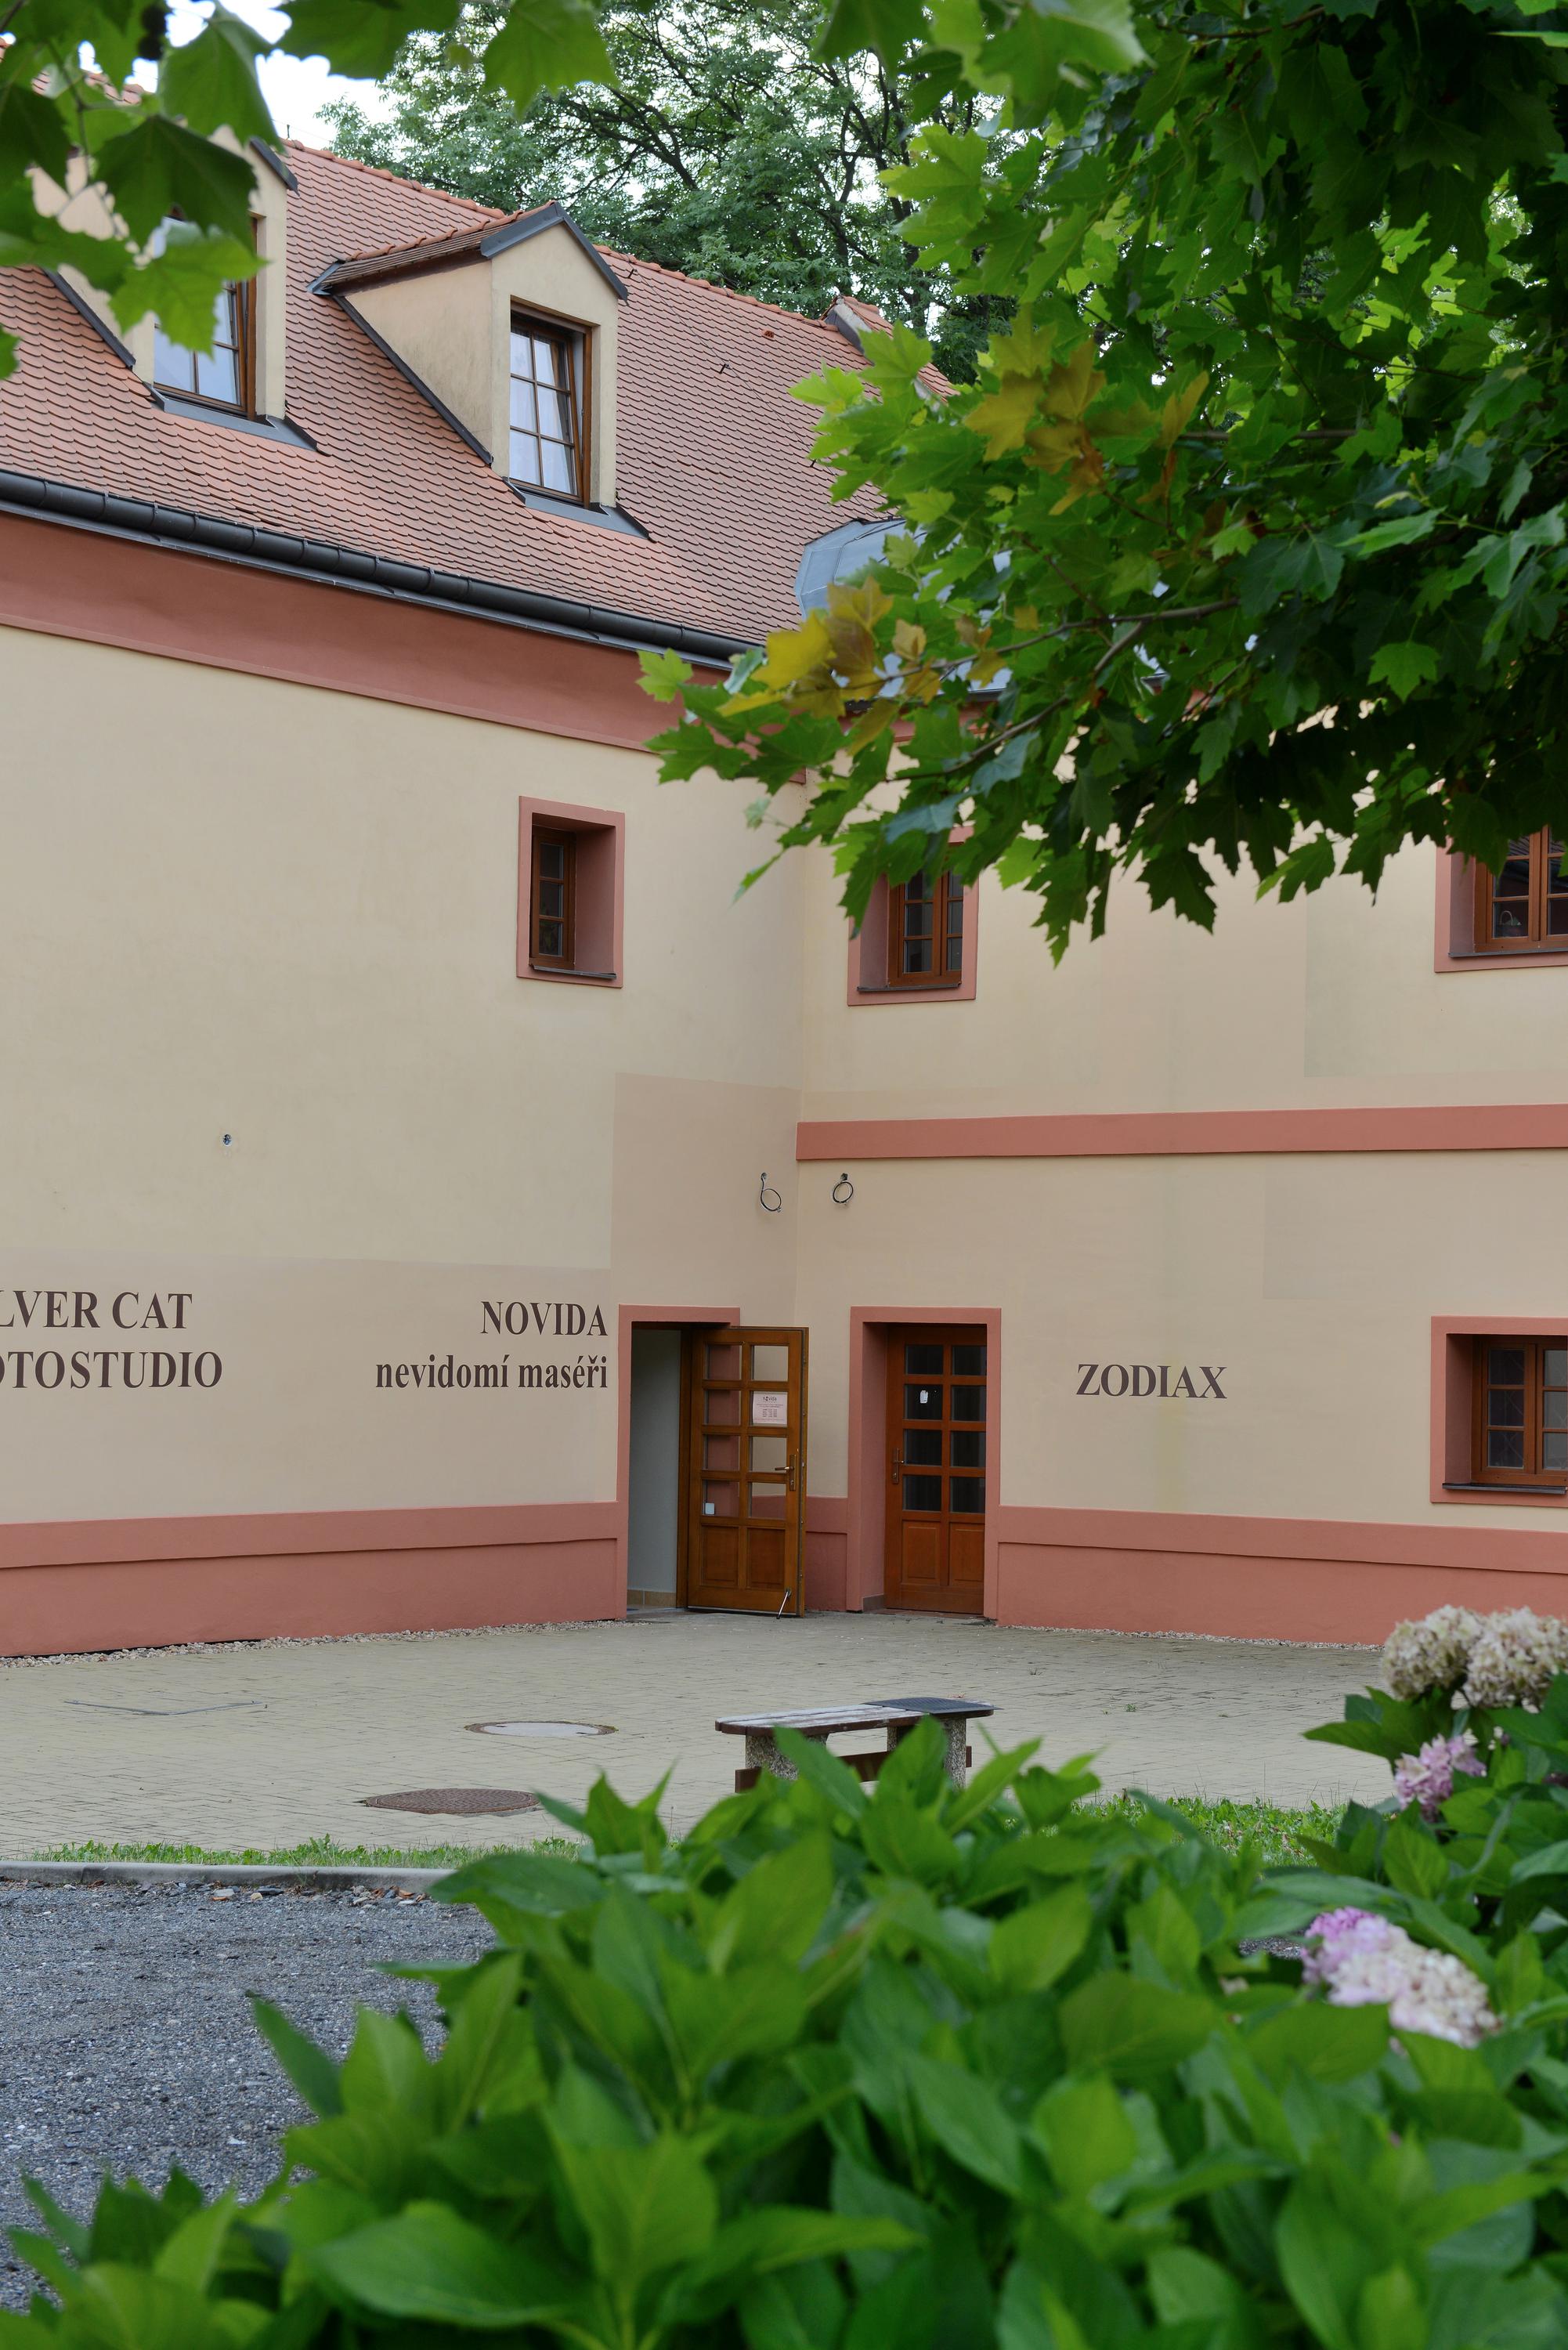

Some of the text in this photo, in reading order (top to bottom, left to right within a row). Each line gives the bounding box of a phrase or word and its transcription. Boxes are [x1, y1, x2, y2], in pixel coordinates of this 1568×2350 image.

[112, 1291, 193, 1329] CAT
[479, 1300, 609, 1336] NOVIDA
[0, 1350, 222, 1389] TOSTUDIO
[375, 1354, 609, 1389] nevidomí maséři
[1075, 1363, 1228, 1399] ZODIAX
